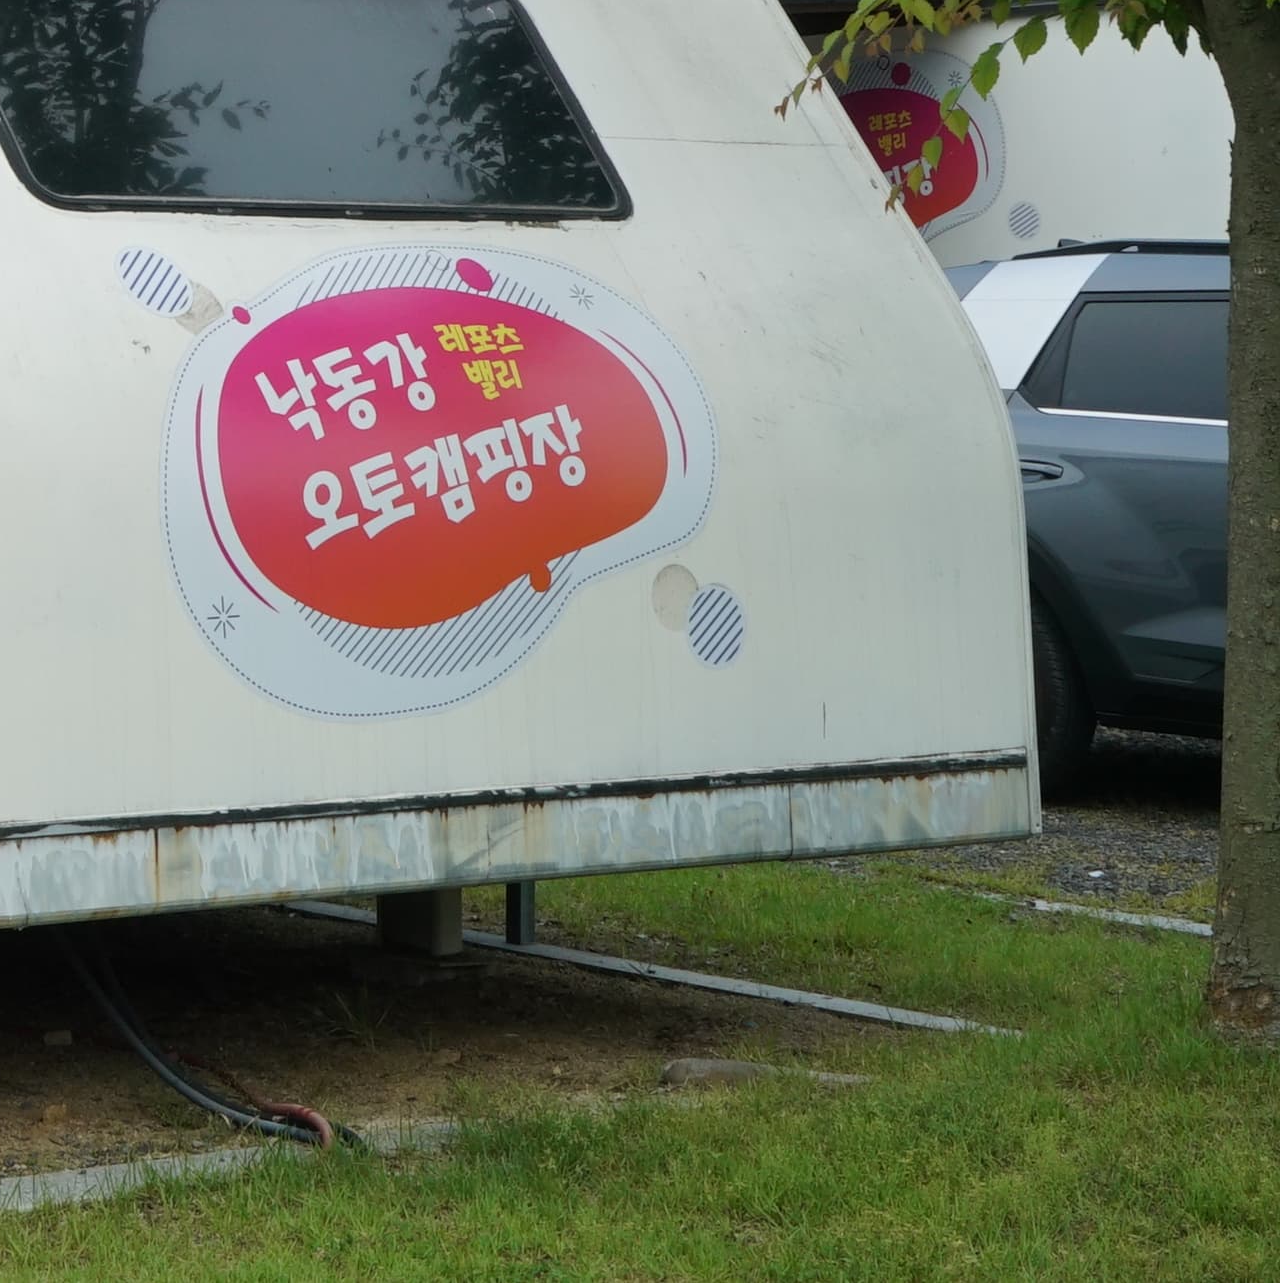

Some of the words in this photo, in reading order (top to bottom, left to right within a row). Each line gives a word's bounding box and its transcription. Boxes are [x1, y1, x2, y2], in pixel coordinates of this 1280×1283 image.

[868, 109, 912, 132] 레포츠
[878, 132, 906, 156] 밸리
[433, 323, 524, 355] 레포츠
[254, 332, 436, 441] 낙동강
[462, 359, 523, 400] 밸리
[302, 404, 587, 551] 오토캠핑장
